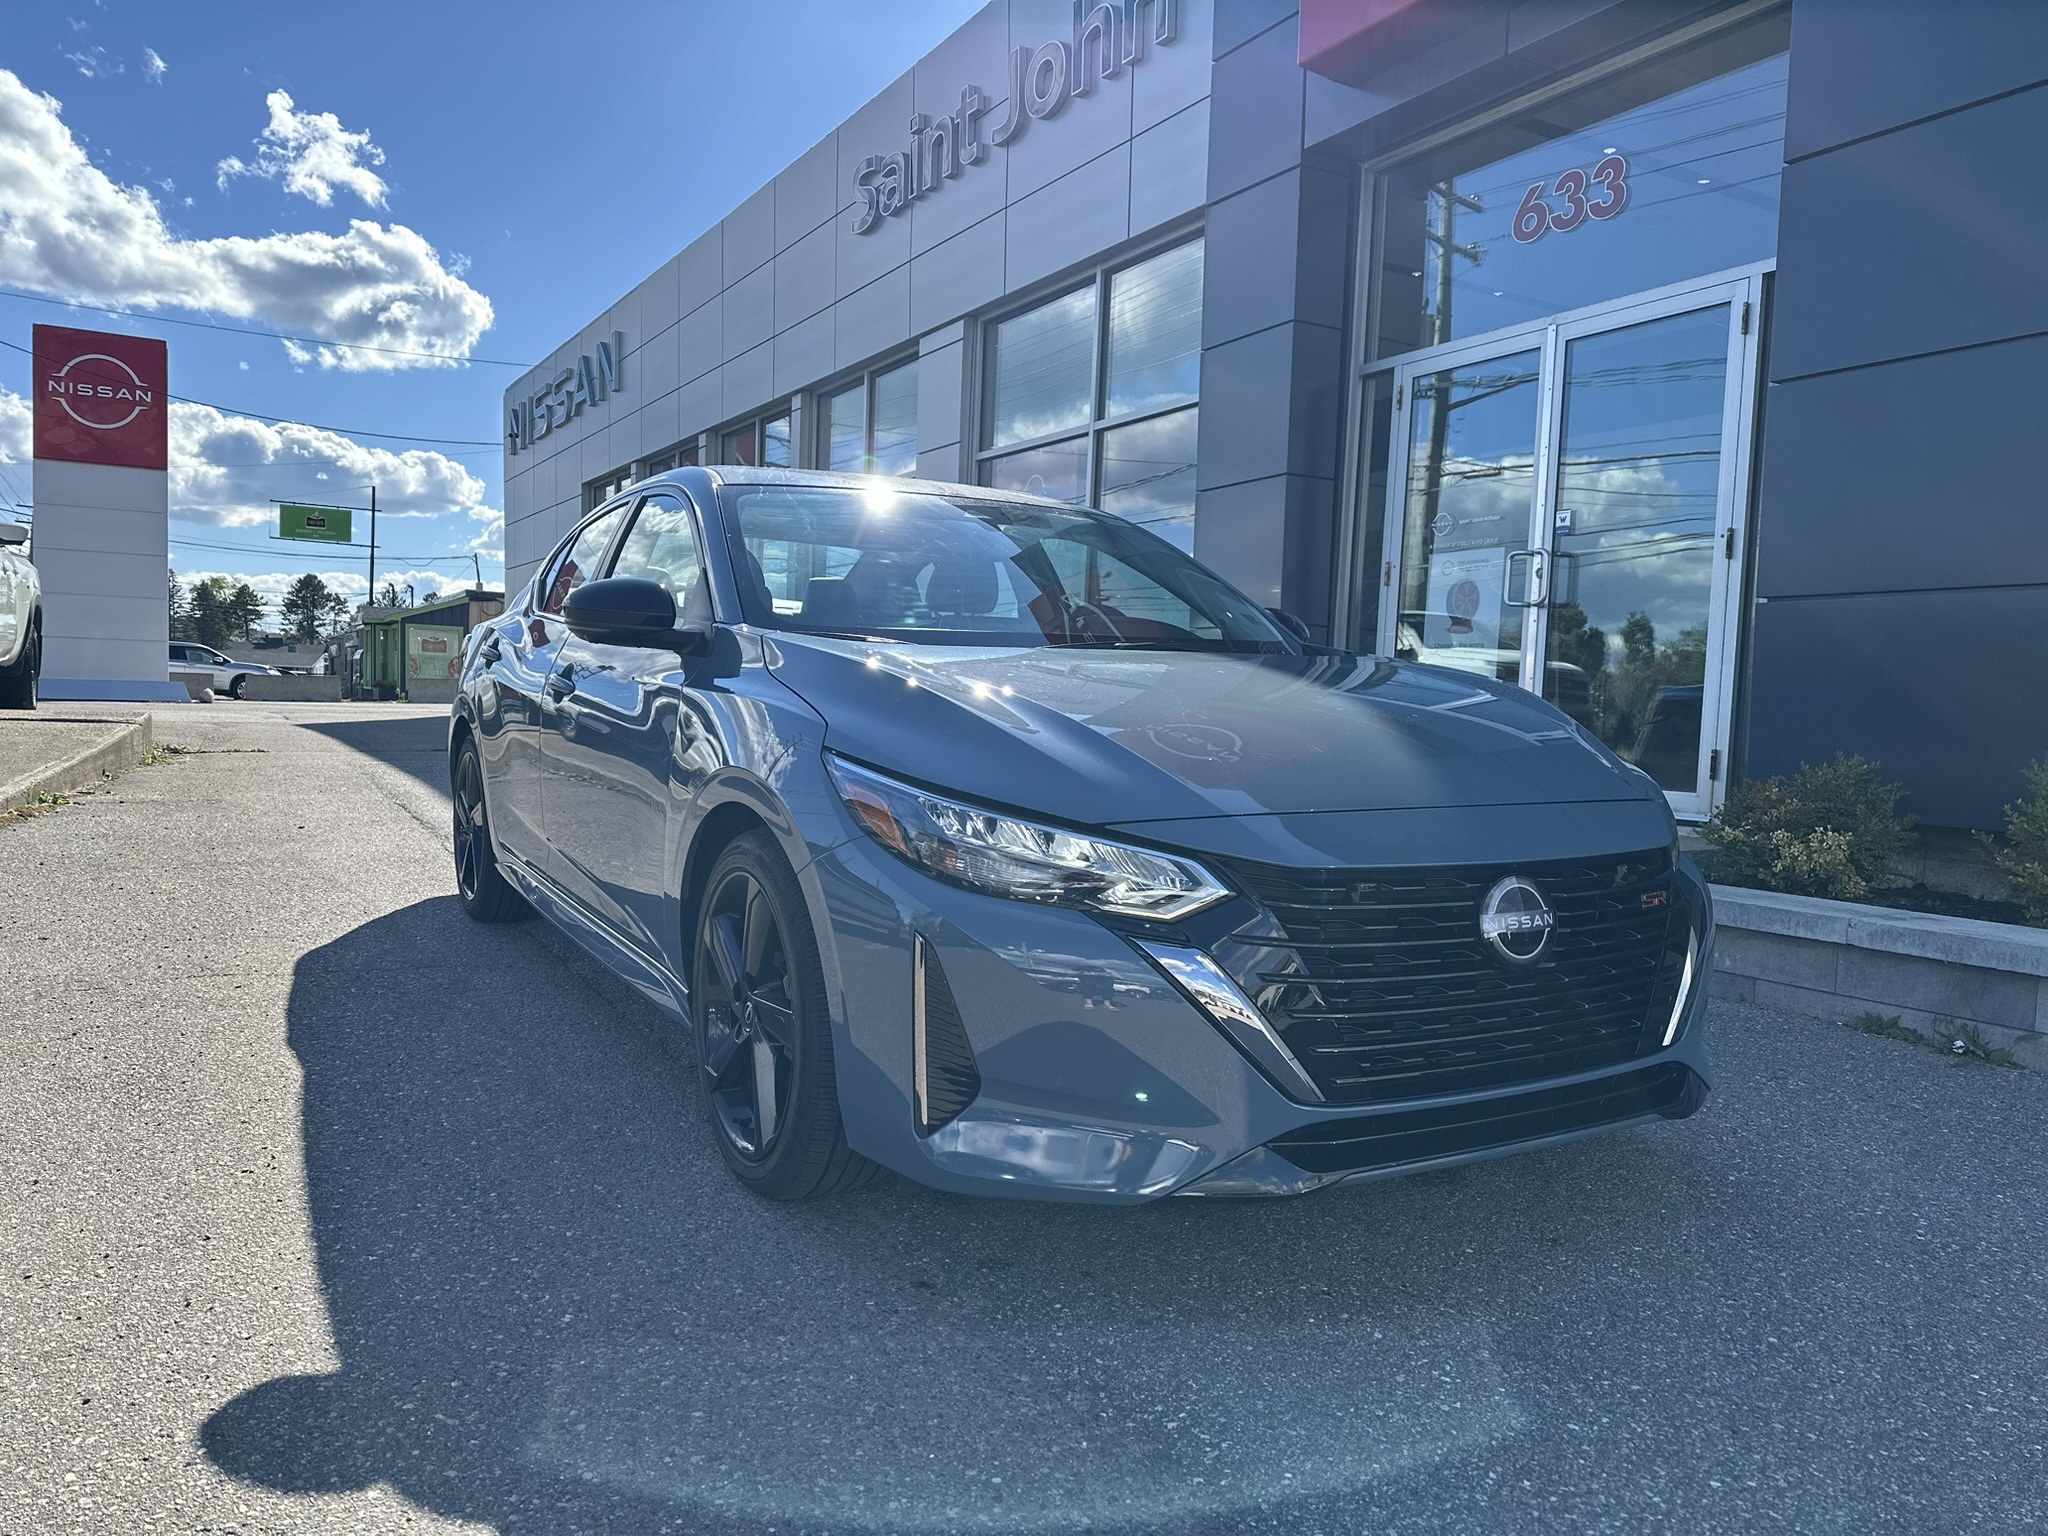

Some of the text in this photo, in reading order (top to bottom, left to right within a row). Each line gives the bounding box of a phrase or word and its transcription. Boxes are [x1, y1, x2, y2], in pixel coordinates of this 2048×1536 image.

[852, 0, 1176, 234] Saint John
[1511, 155, 1628, 244] 633
[48, 380, 152, 403] NISSAN
[508, 330, 621, 456] NISSAN
[1485, 913, 1554, 930] NISSAN
[1641, 891, 1668, 909] SR
